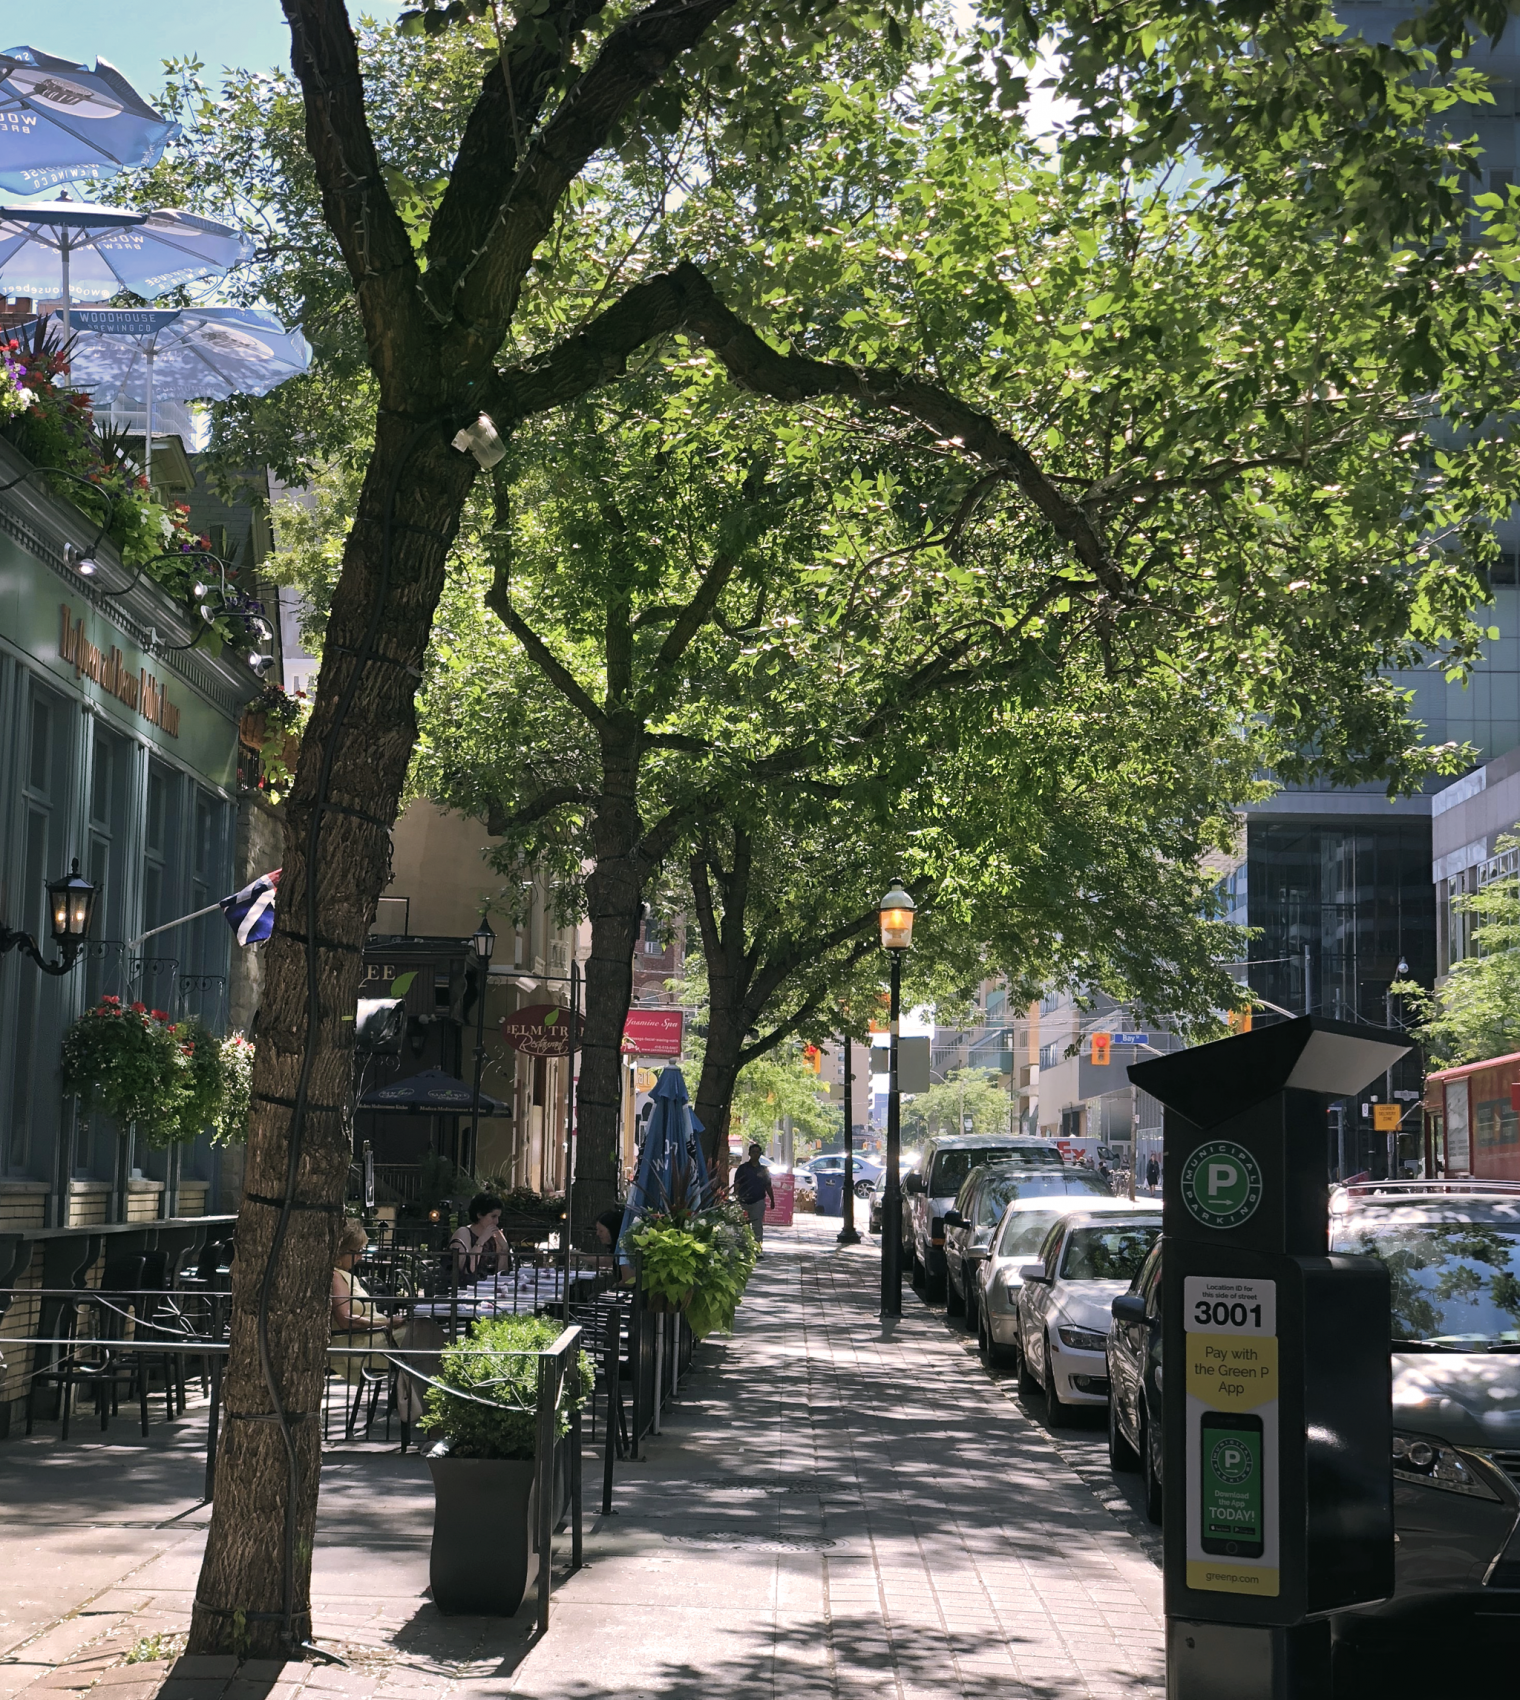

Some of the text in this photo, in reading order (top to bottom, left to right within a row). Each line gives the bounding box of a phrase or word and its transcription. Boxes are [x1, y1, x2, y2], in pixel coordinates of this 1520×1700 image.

[79, 312, 156, 323] WOODHOUSE
[511, 1024, 543, 1036] ELM
[625, 1016, 678, 1031] Jasmine Spa
[1122, 1033, 1135, 1043] Bay
[1186, 1145, 1256, 1182] MUNICIPAL
[1208, 1164, 1238, 1196] P
[1186, 1191, 1257, 1225] PARKING
[1194, 1300, 1262, 1328] 3001
[1205, 1347, 1258, 1362] Pay with
[1194, 1363, 1269, 1378] the Green P
[1218, 1382, 1245, 1397] App
[1225, 1450, 1241, 1468] P
[1214, 1490, 1249, 1499] Download
[1231, 1500, 1245, 1508] App
[1209, 1507, 1255, 1522] TODAY!
[1205, 1571, 1259, 1584] greenp.com
